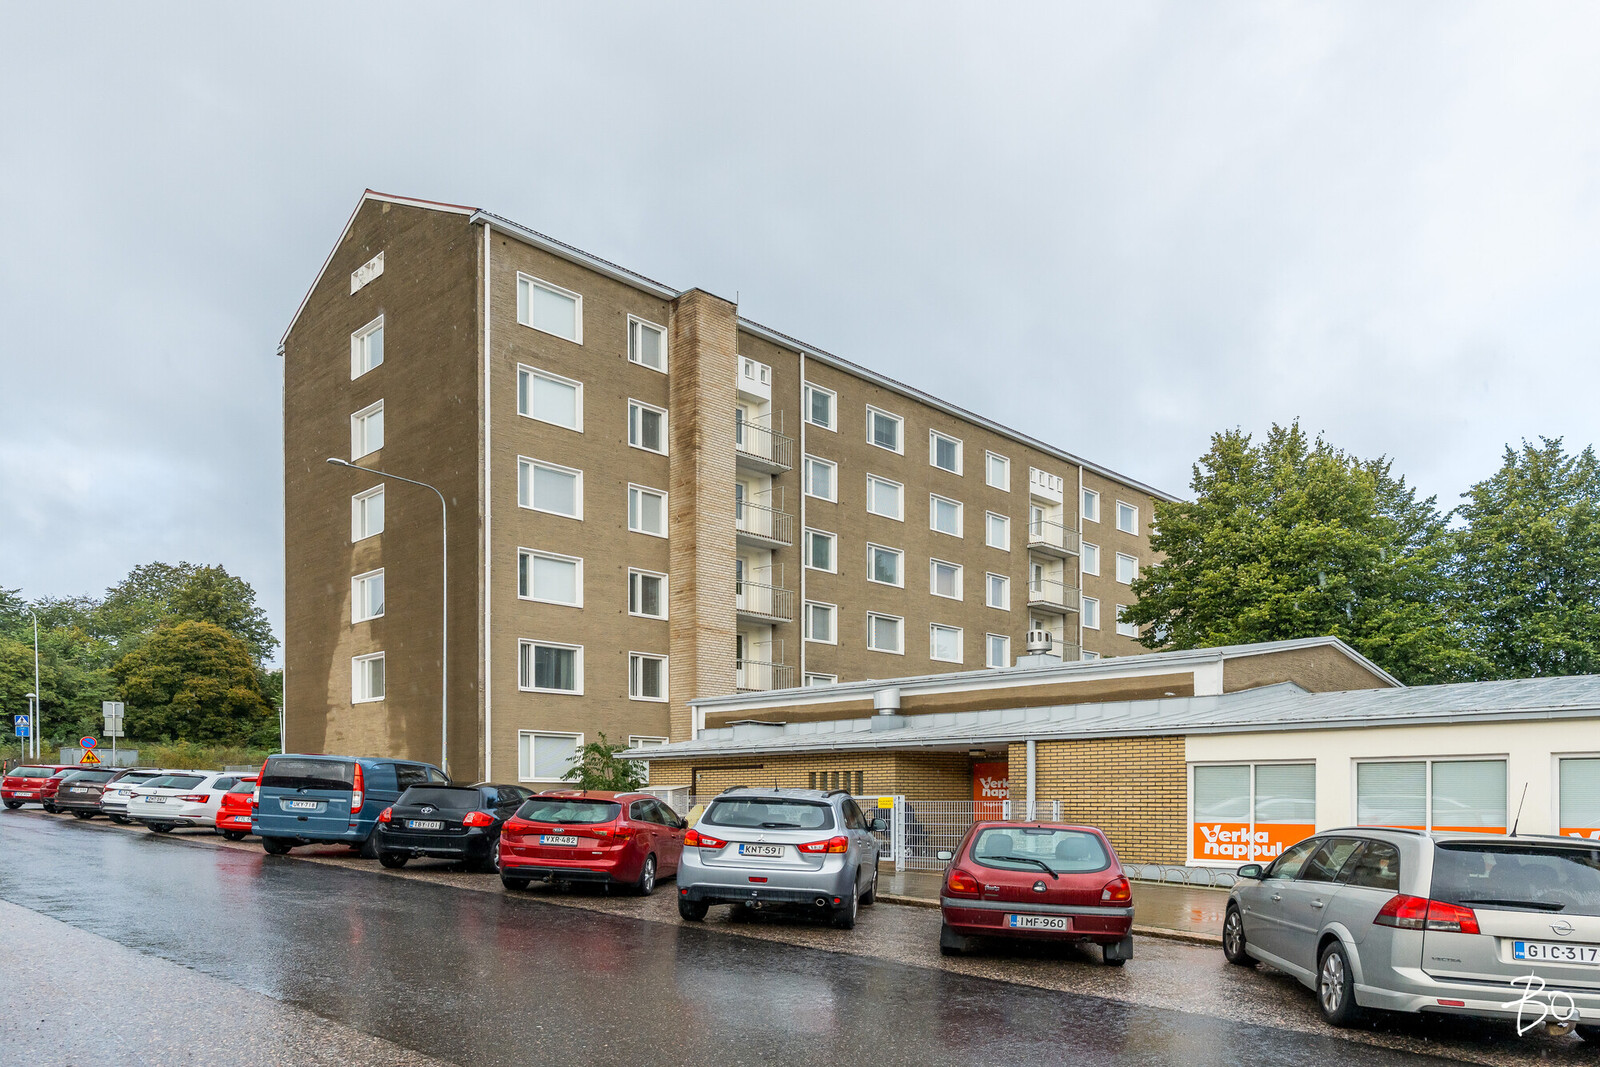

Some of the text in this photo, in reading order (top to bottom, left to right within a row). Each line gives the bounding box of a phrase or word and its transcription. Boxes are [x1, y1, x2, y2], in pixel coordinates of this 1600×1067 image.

[1200, 824, 1269, 843] Verka
[545, 835, 576, 844] VXR-482
[745, 845, 782, 854] KNT-591
[1020, 917, 1064, 928] IMF-960
[1528, 945, 1598, 961] GIC-317
